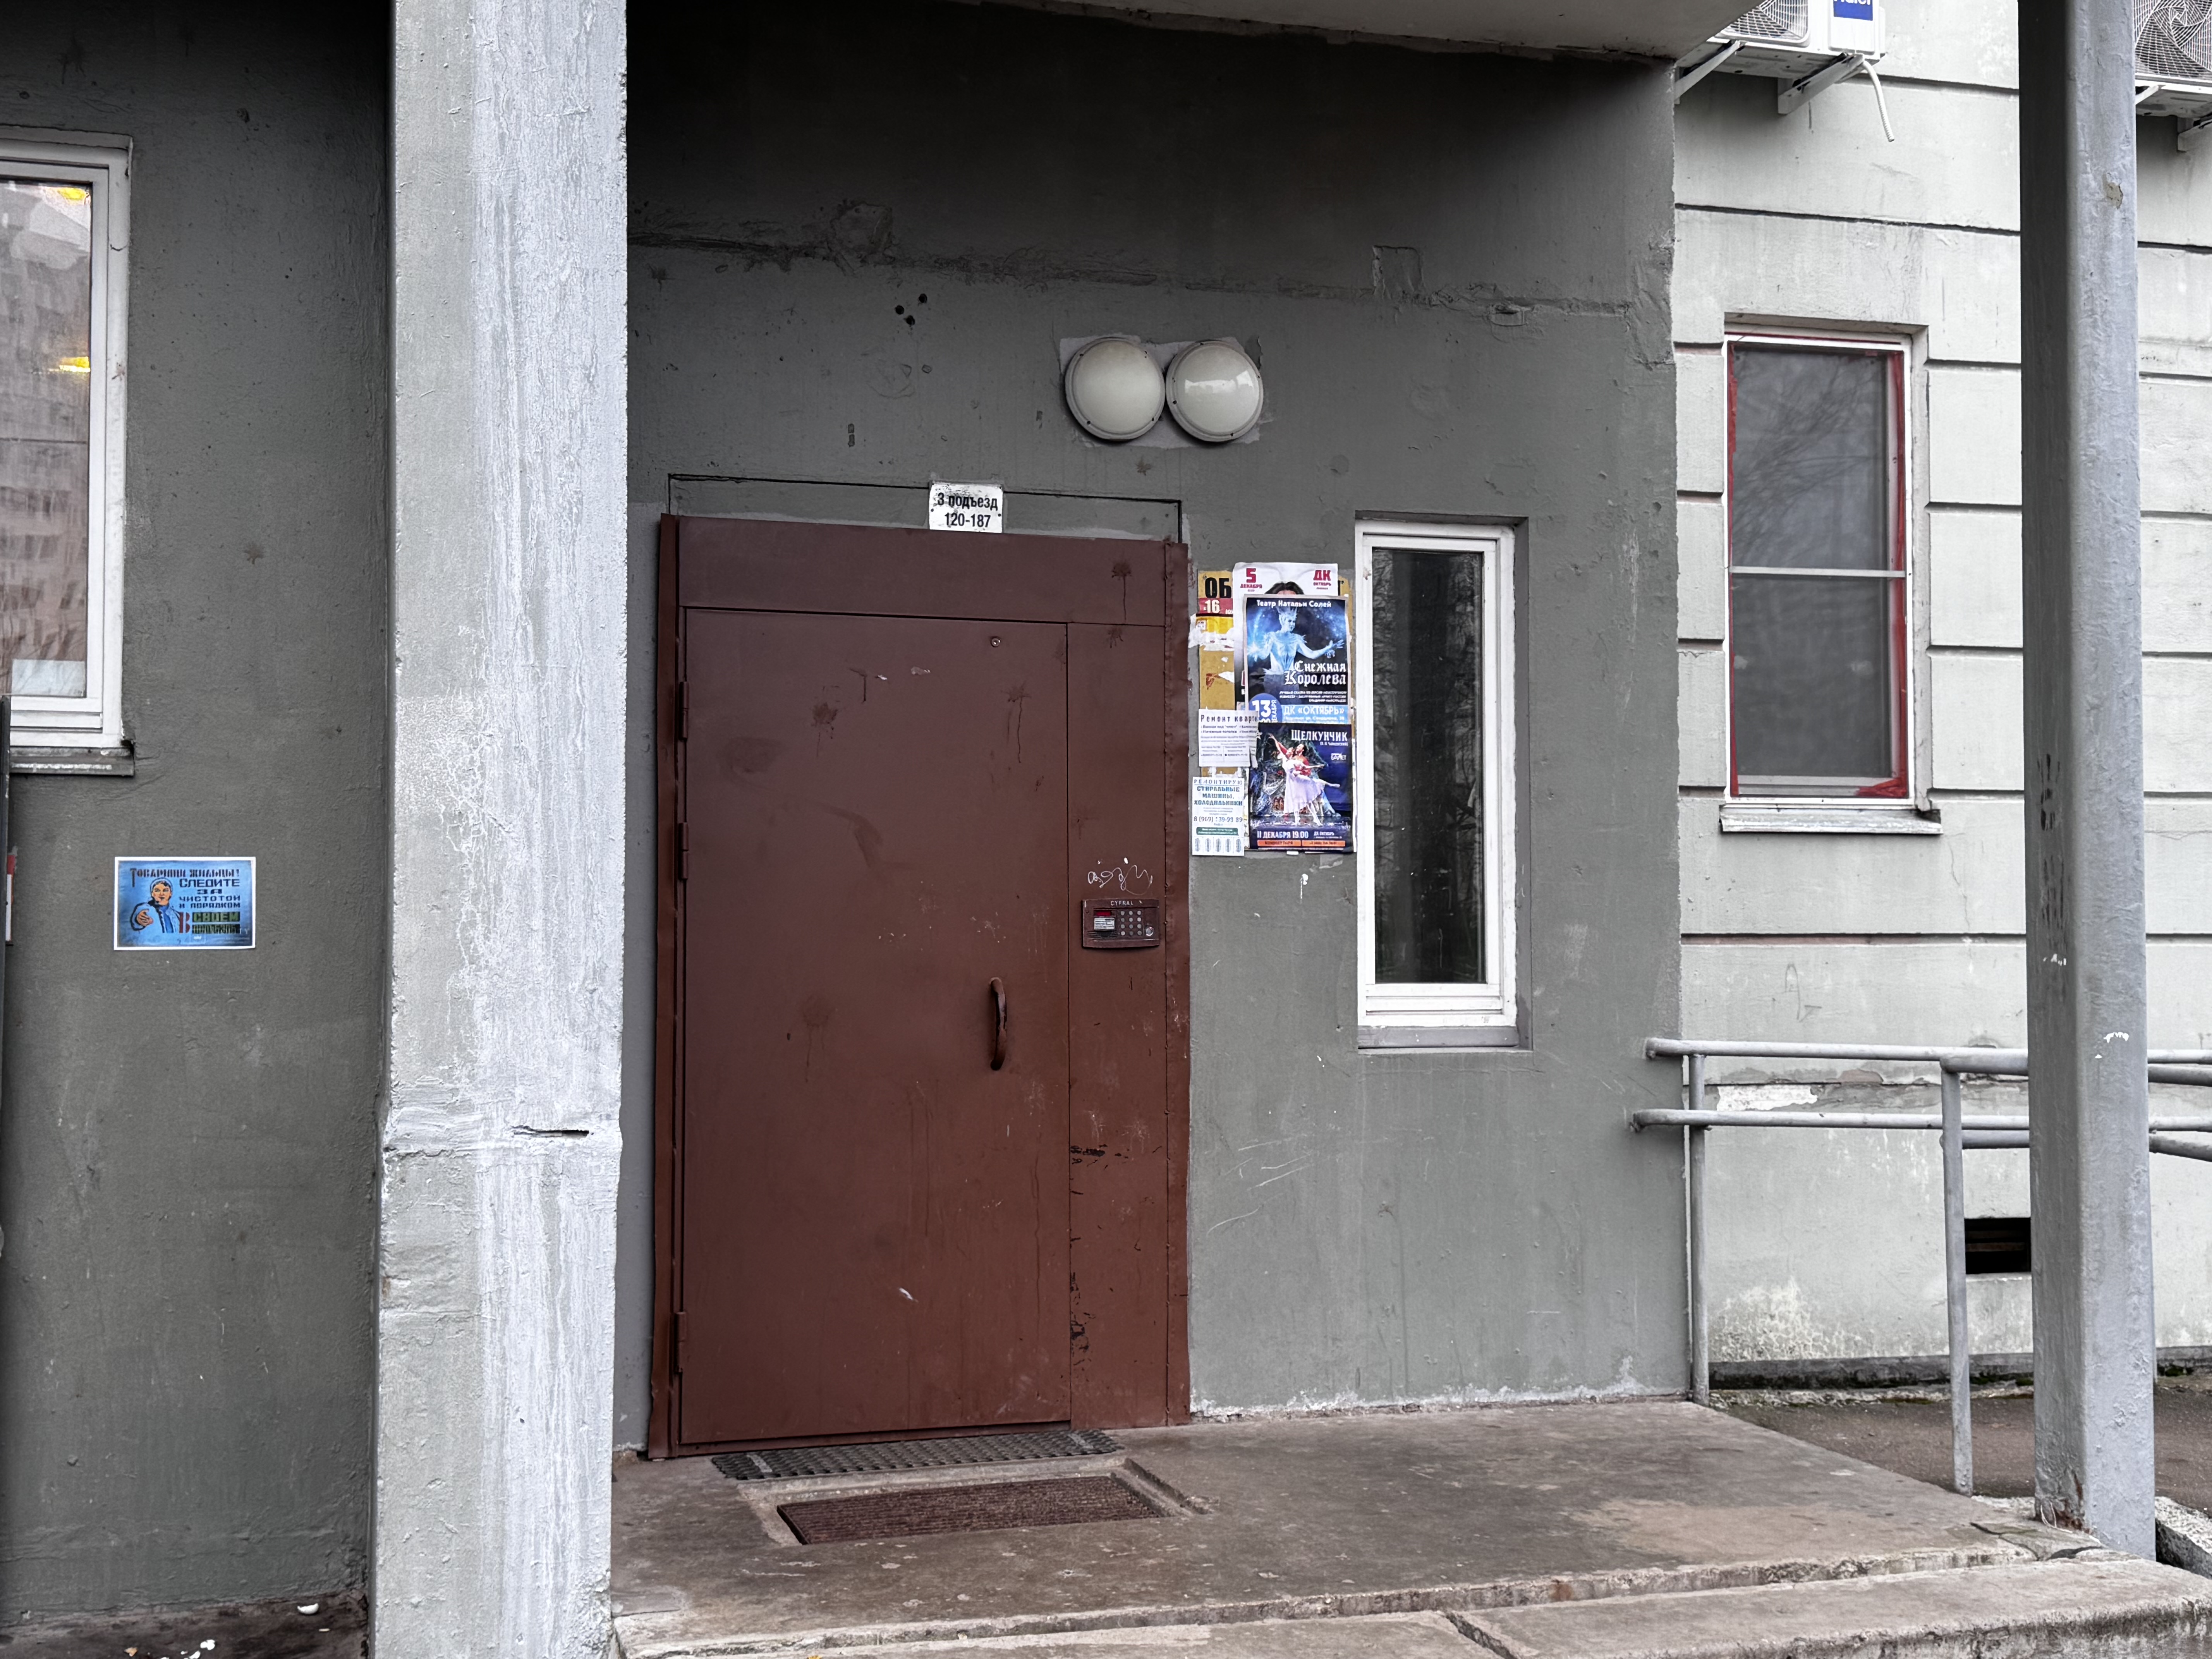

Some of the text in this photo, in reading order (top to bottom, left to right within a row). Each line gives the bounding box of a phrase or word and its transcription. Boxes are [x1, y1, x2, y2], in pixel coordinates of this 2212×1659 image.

[938, 492, 998, 511] 3 подъезд
[945, 512, 991, 527] 120-187
[1246, 568, 1256, 583] 5
[1313, 570, 1331, 581] ДК
[1205, 599, 1220, 613] 16
[1257, 600, 1276, 608] Театр
[1295, 660, 1346, 672] Снежная
[1284, 671, 1346, 687] Королева
[1252, 700, 1271, 717] 13
[1284, 706, 1344, 715] ДК «ОКТЯБРЬ»
[1291, 730, 1348, 741] ЩЕЛКУНЧИК
[179, 879, 240, 888] СЛЕДИТЕ
[179, 912, 240, 933] В СВОЕМ
